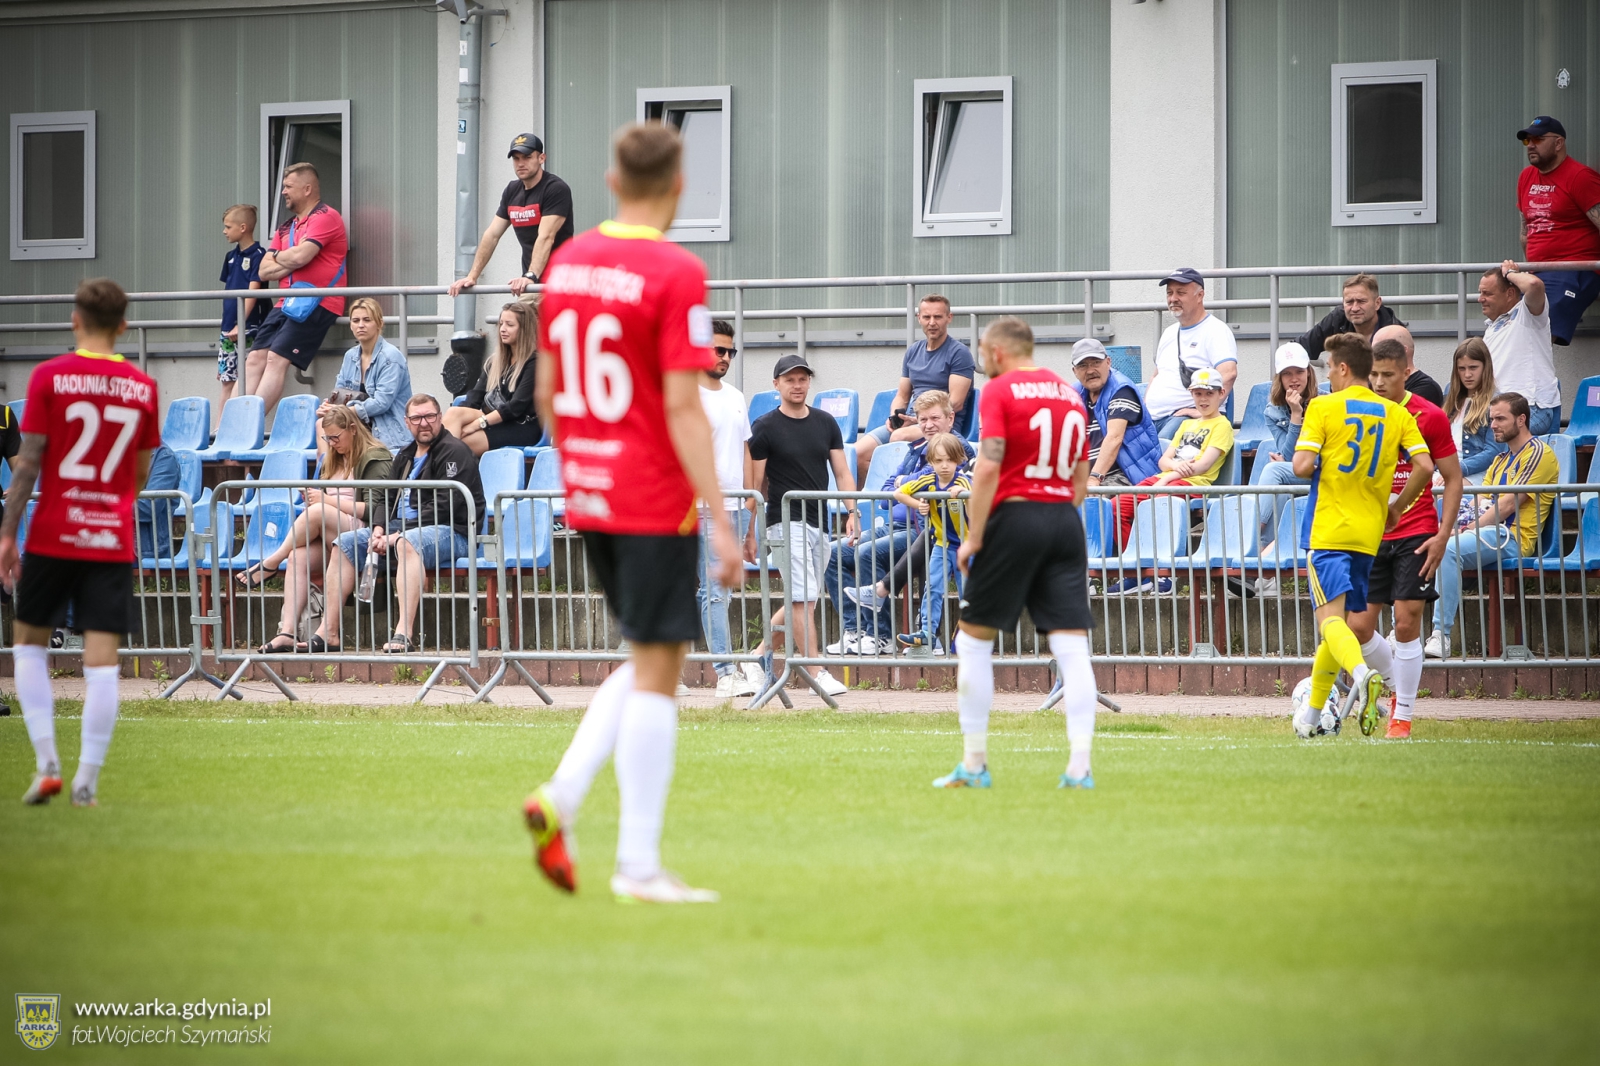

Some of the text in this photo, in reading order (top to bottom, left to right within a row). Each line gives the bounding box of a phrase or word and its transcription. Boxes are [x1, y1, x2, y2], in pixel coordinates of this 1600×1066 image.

[53, 374, 108, 396] RADUNIA
[548, 308, 633, 423] 16
[58, 401, 141, 483] 27
[1024, 407, 1086, 480] 10
[1337, 416, 1385, 478] 31
